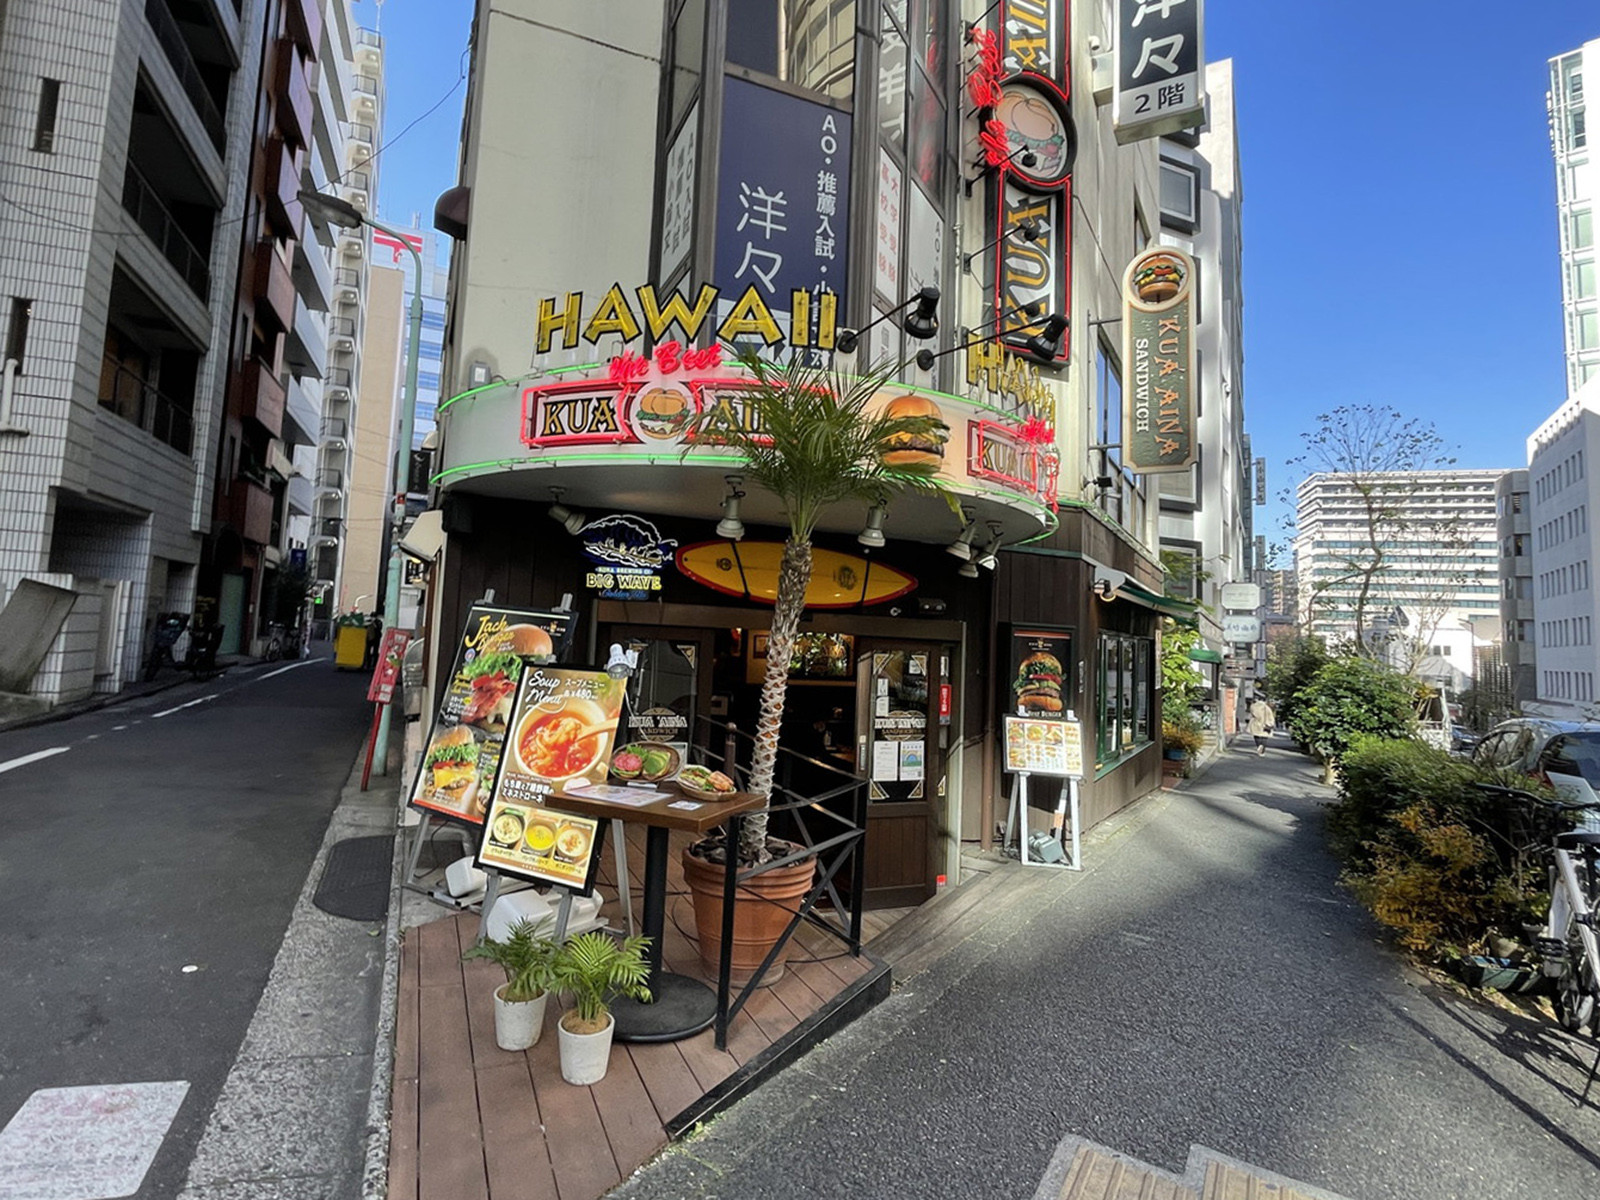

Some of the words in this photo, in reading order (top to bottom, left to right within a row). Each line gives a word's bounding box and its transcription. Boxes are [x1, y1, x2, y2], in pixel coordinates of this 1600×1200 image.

[1008, 0, 1047, 67] AI
[1134, 82, 1185, 114] 2階
[735, 180, 788, 294] 洋々
[1006, 203, 1048, 339] KUA
[535, 282, 839, 355] HAWAII
[654, 340, 722, 375] Best
[1135, 338, 1149, 433] SANDWICH
[542, 395, 619, 436] KUA
[586, 573, 614, 588] BIG
[616, 574, 662, 590] WAVE
[464, 614, 507, 647] Jack
[525, 688, 561, 705] Menu
[528, 670, 560, 695] Soup
[565, 678, 605, 689] スープメニュー
